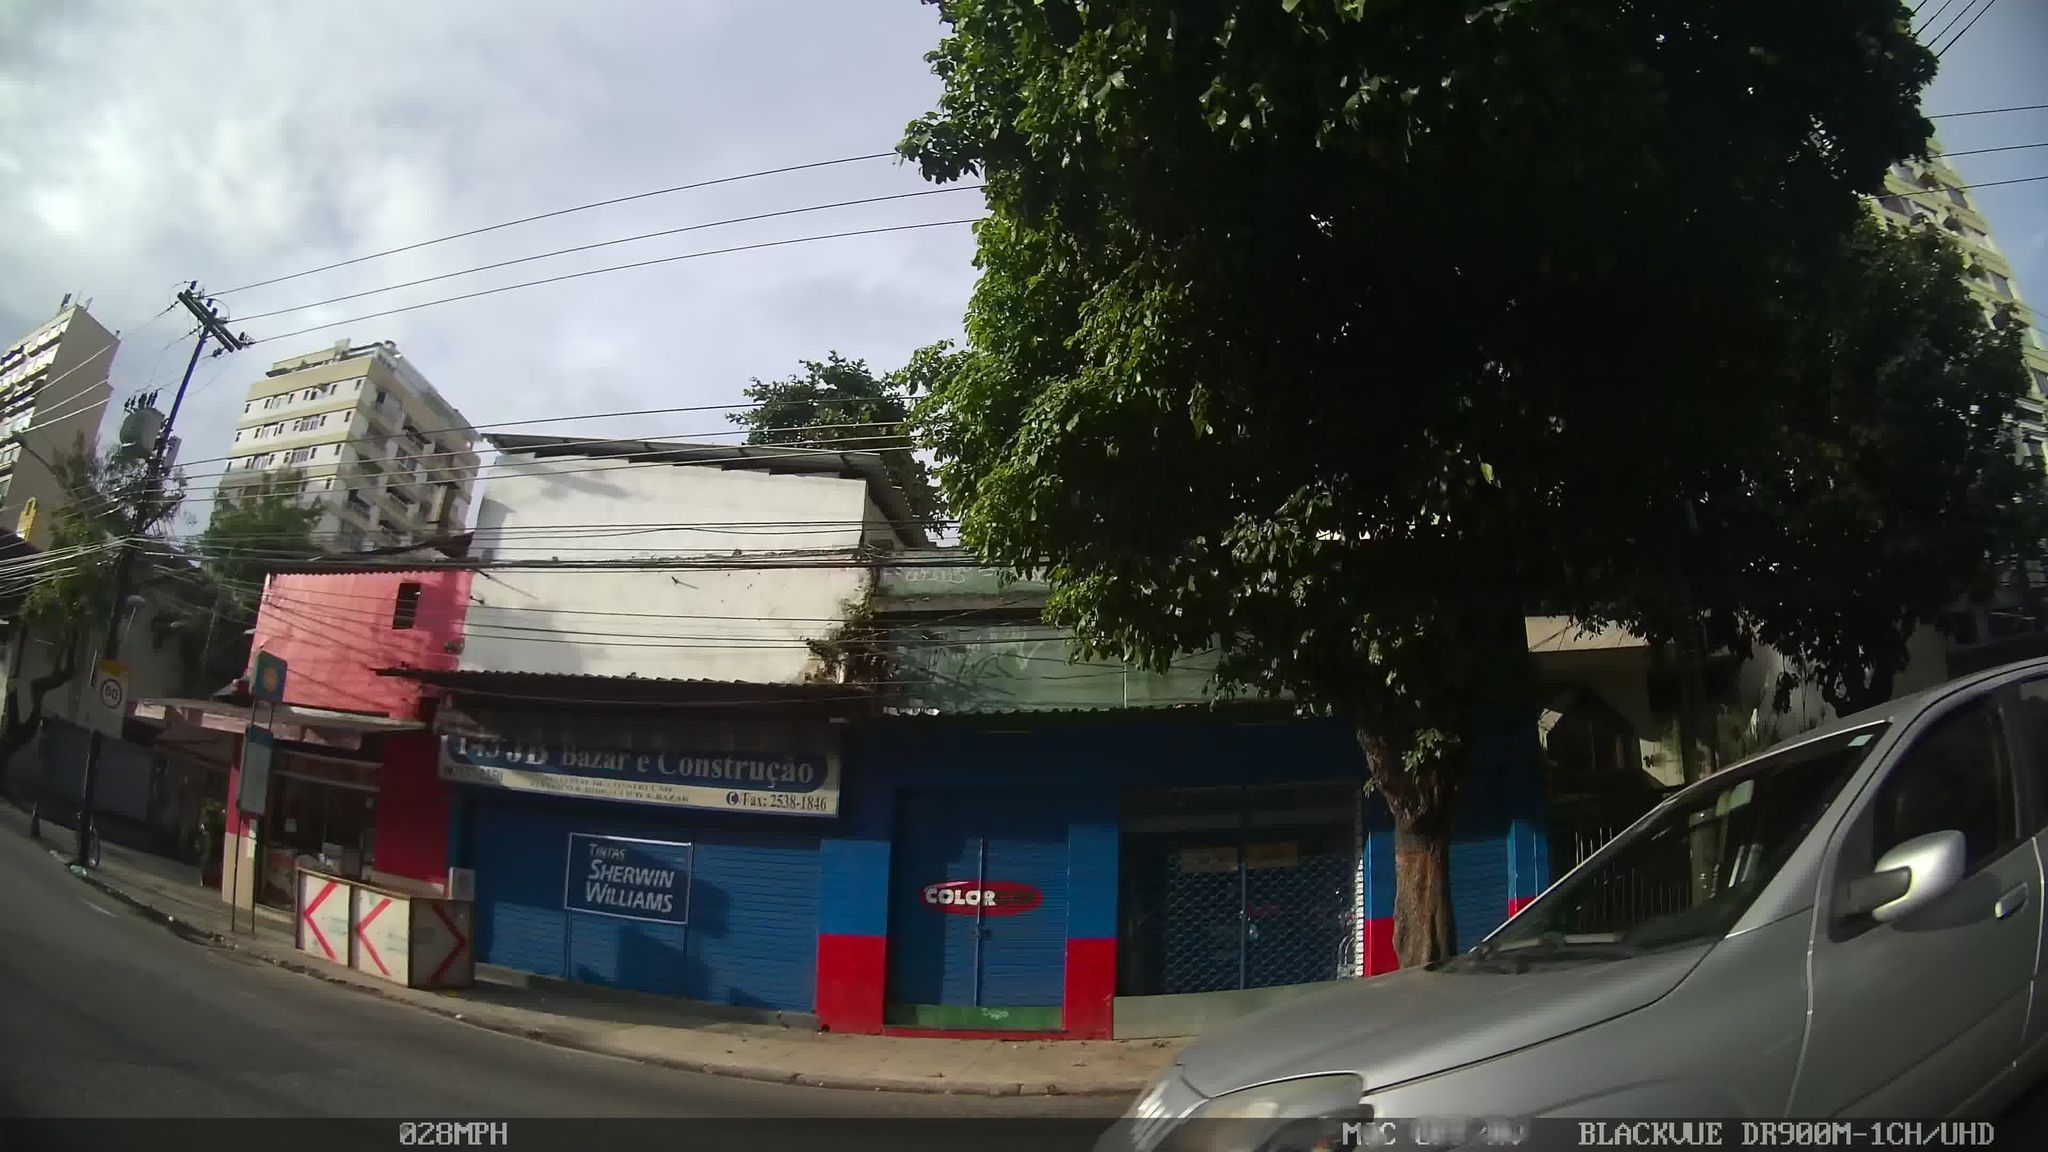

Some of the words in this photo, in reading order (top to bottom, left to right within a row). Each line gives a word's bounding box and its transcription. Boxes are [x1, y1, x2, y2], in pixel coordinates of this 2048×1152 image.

[561, 744, 632, 772] Bazar
[637, 751, 651, 774] e
[657, 751, 815, 788] Construção
[769, 794, 827, 811] 2538-1846
[588, 843, 627, 861] TINTAS
[588, 858, 675, 889] SHERWIN
[585, 881, 674, 913] WILLIAMS
